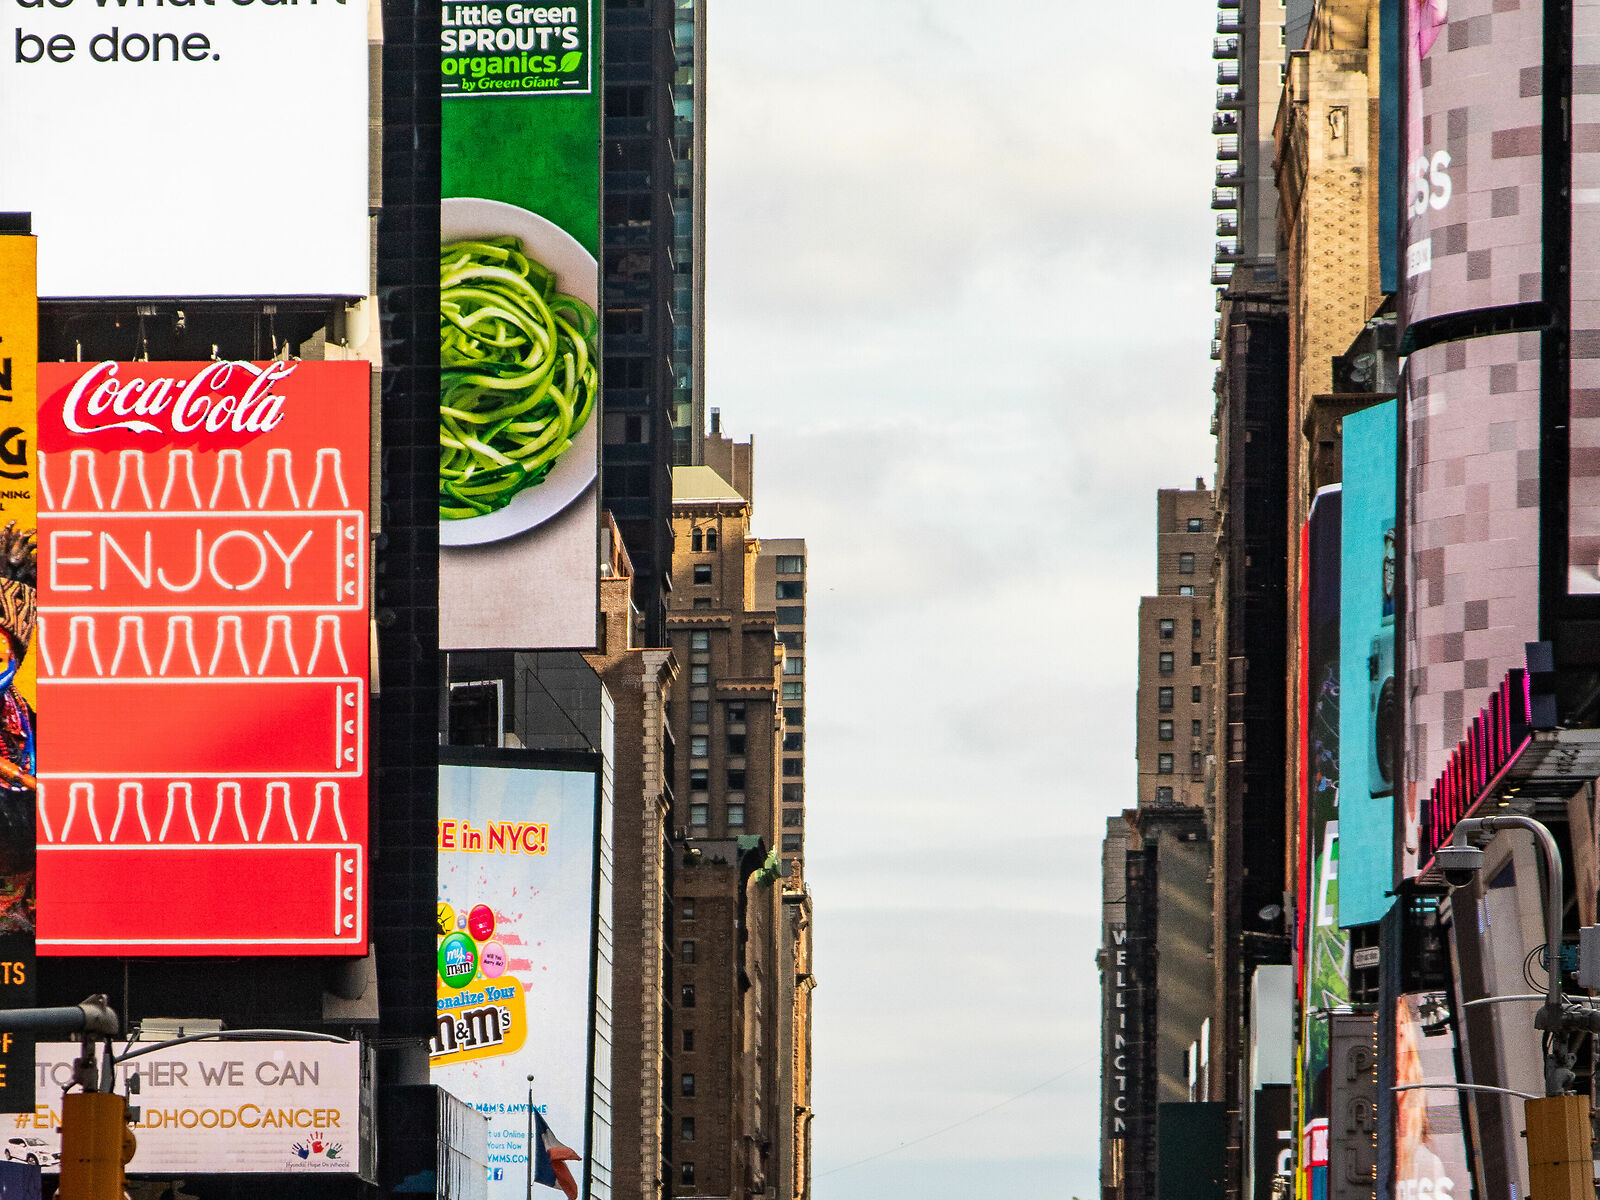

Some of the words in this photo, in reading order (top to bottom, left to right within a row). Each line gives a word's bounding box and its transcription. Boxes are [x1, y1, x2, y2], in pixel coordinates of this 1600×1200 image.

[442, 5, 502, 26] Little
[506, 4, 577, 24] Green
[15, 28, 75, 62] be
[89, 27, 220, 62] done.
[441, 27, 579, 51] SPROUT'S
[441, 51, 557, 77] organics
[462, 78, 476, 91] by
[478, 77, 519, 89] Green
[521, 75, 560, 88] Giant
[63, 360, 297, 433] Coca-Cola
[50, 529, 313, 592] ENJOY
[463, 824, 481, 849] in
[489, 824, 546, 853] NYC!
[447, 949, 465, 964] my
[437, 994, 485, 1011] onalize
[485, 986, 516, 1004] Your
[37, 1062, 188, 1086] TOTHER
[199, 1061, 244, 1086] WE
[256, 1061, 319, 1086] CAN
[475, 1103, 505, 1113] M&M'S
[503, 1129, 525, 1138] Online
